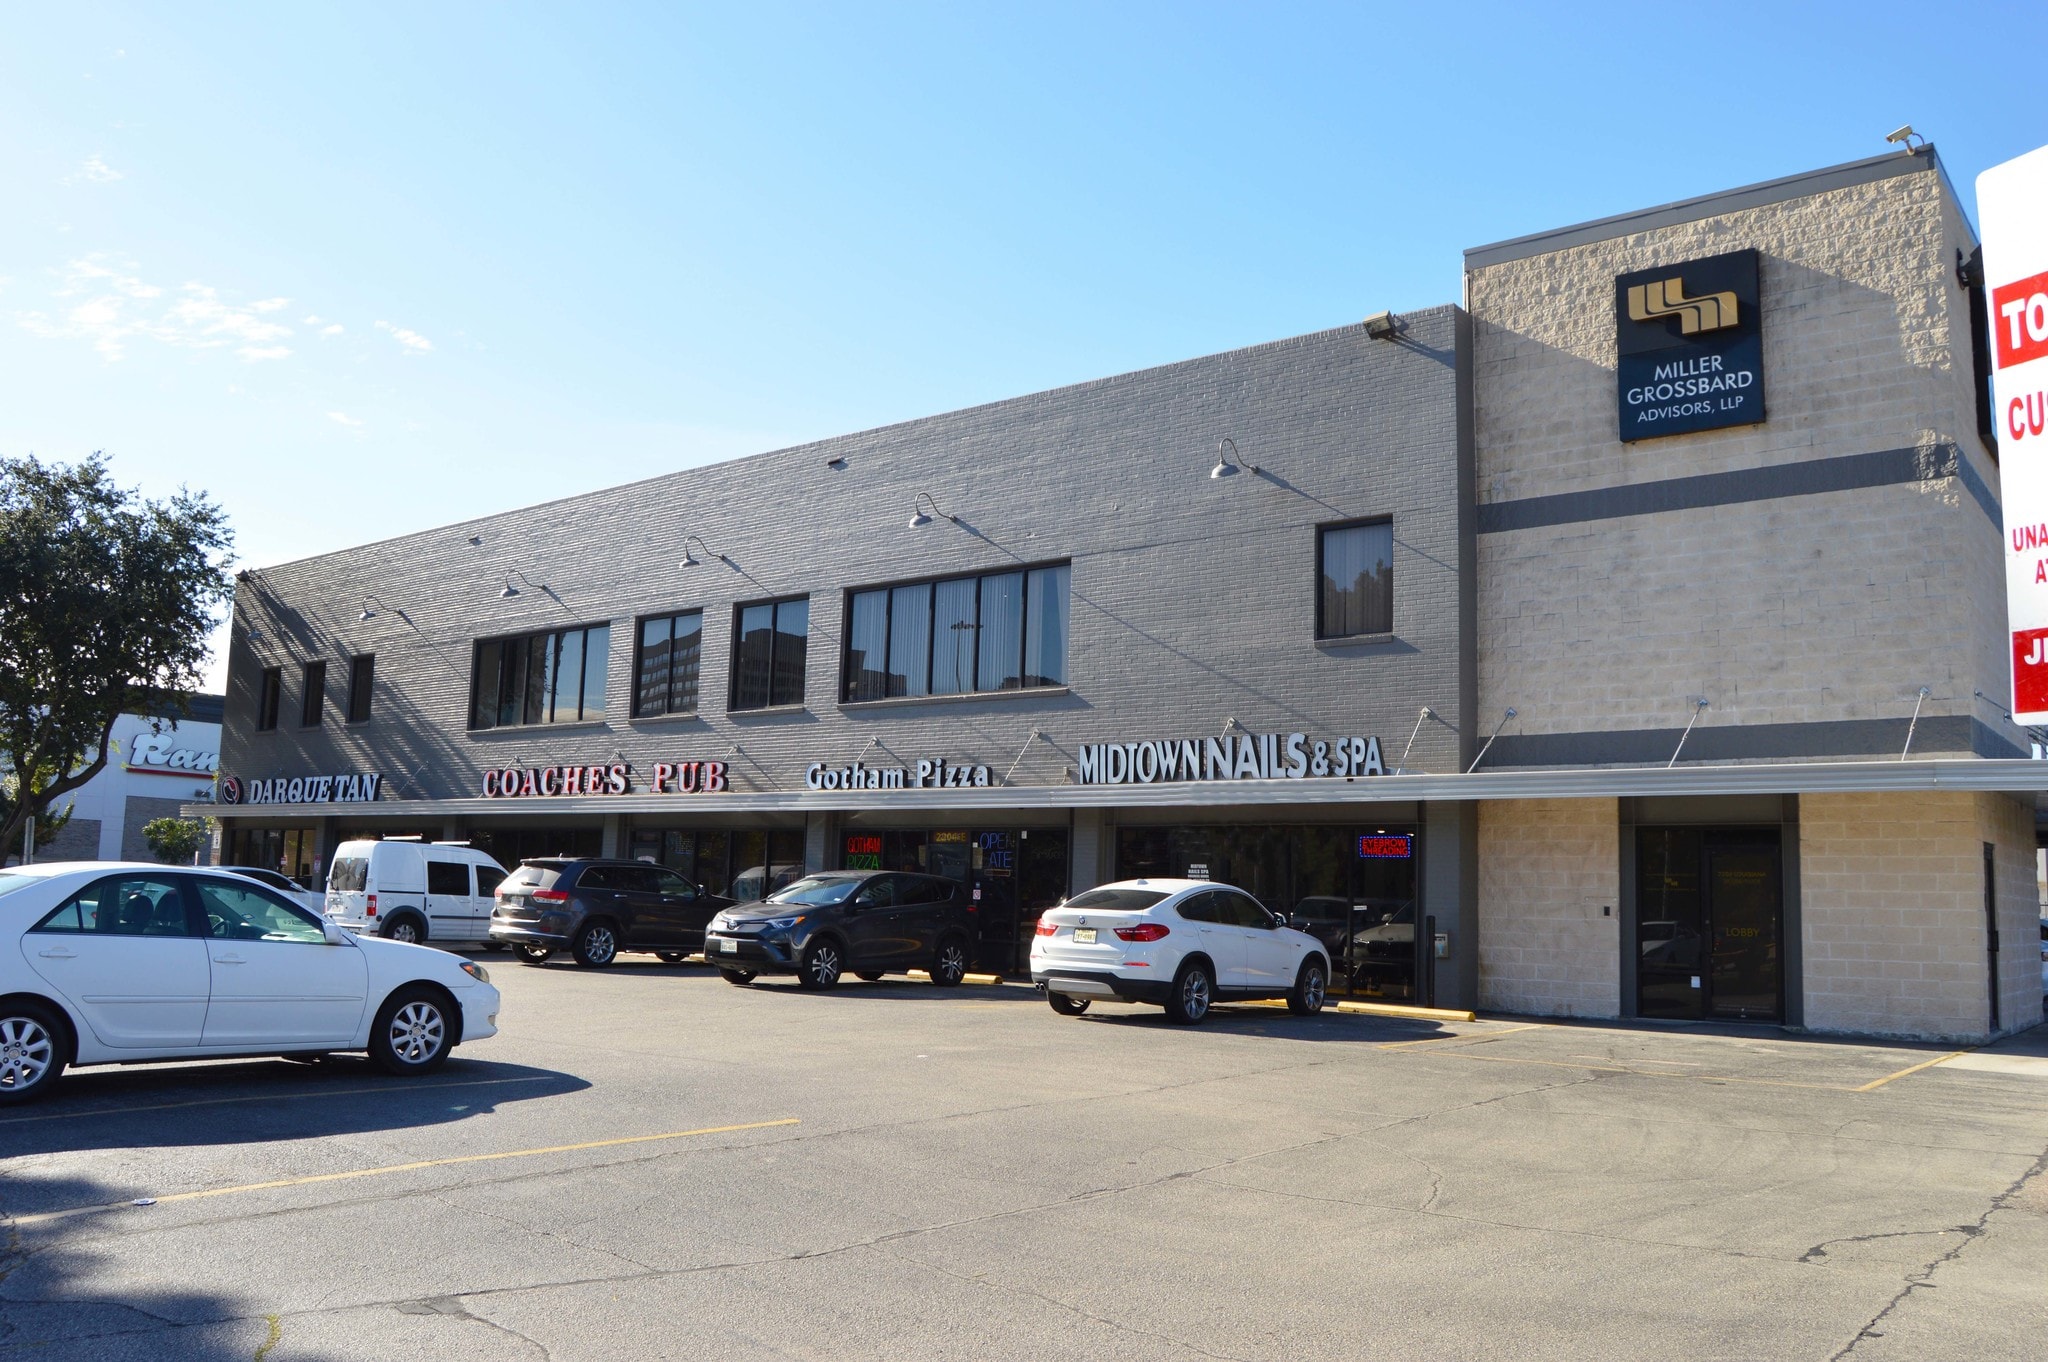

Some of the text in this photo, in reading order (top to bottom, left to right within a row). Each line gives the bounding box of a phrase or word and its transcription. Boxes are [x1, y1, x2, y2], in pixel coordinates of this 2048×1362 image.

[1654, 355, 1723, 381] MILLER
[1627, 371, 1753, 404] GROSSBARD
[1637, 396, 1744, 423] ADVISORS, LLP
[2008, 391, 2048, 440] CU
[2036, 558, 2048, 584] A
[1079, 733, 1384, 784] MIDTOWN NAILS & SPA
[482, 761, 725, 797] COACHES PUB
[805, 758, 989, 790] Gotham Pizza
[249, 773, 379, 804] DARQUE TAN
[848, 837, 880, 853] GOTHAM
[1363, 838, 1407, 847] EYEBROW
[1363, 846, 1408, 856] THREADING
[847, 855, 879, 870] PIZZA
[1726, 927, 1760, 937] LOBBY
